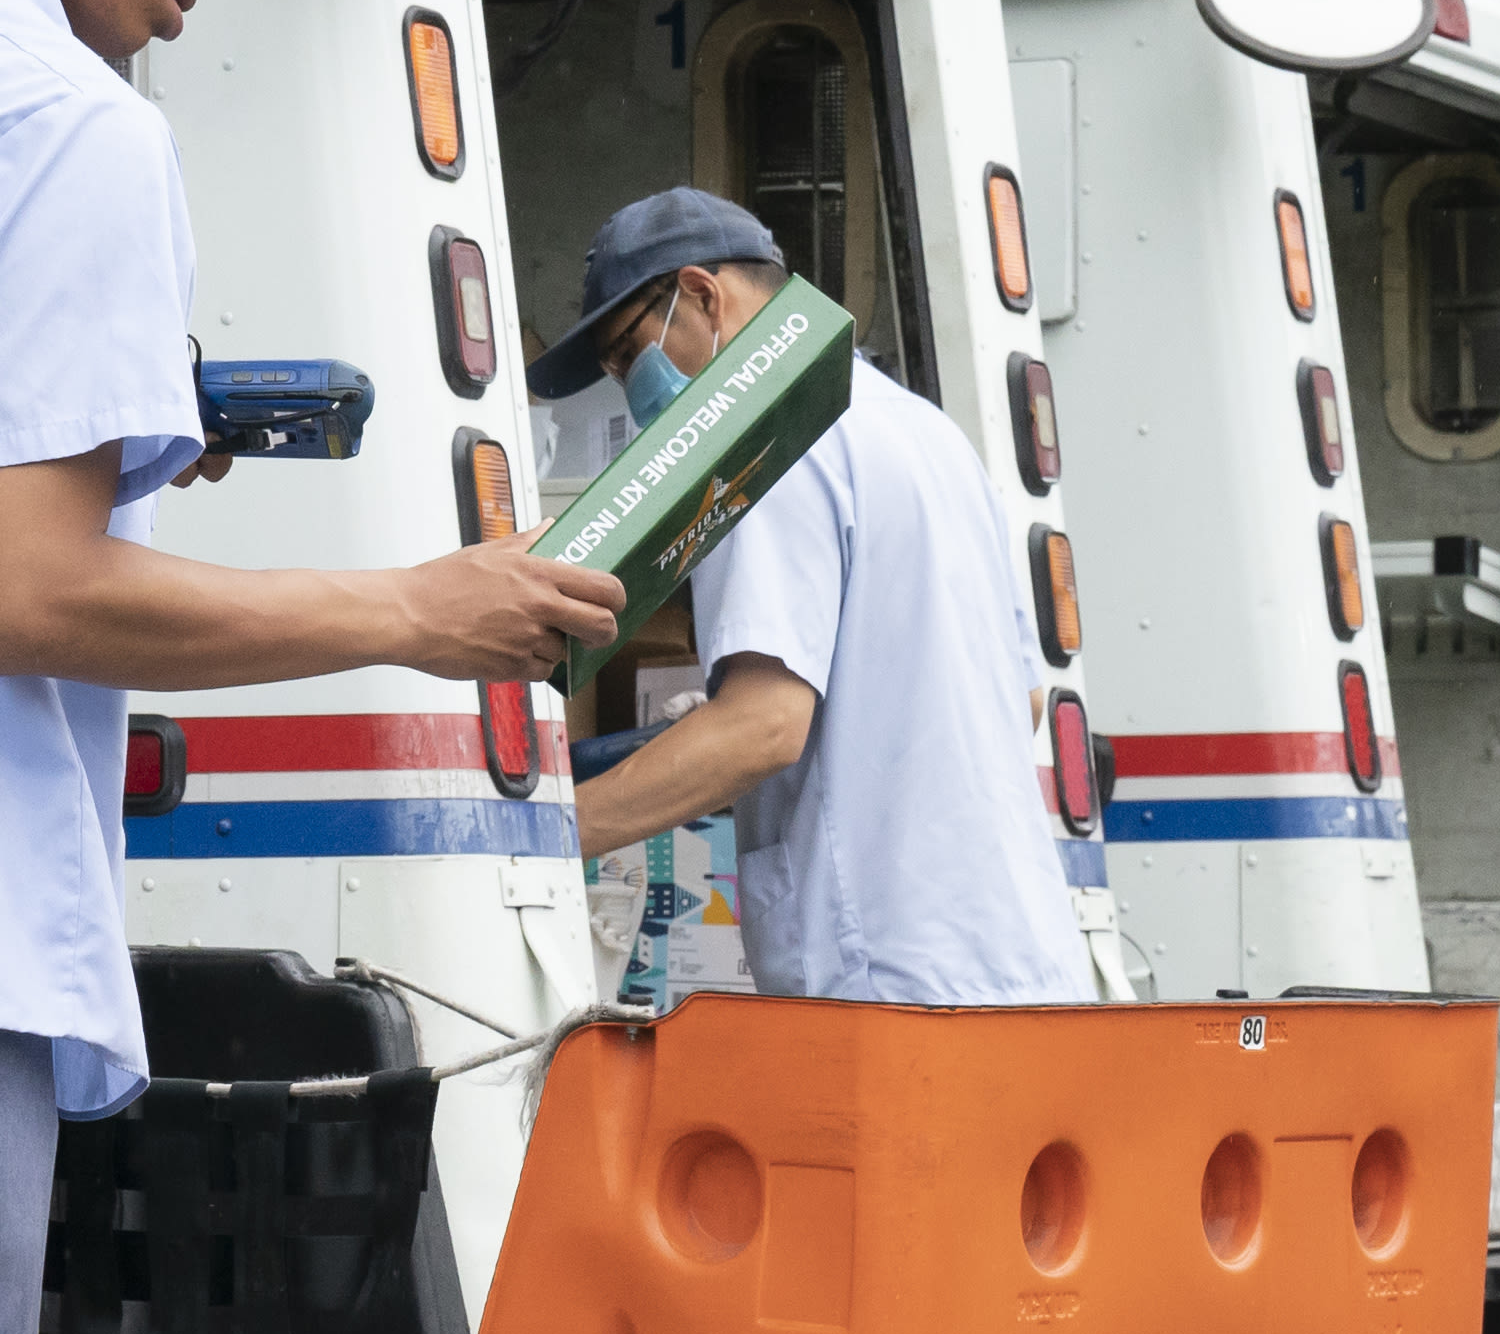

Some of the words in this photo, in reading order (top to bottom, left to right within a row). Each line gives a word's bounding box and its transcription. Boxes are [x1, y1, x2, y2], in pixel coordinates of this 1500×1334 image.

[655, 0, 686, 70] 1
[1341, 157, 1366, 212] 1
[724, 312, 809, 393] OFFICIAL
[638, 390, 737, 486] WELCOME
[612, 478, 649, 517] KIT
[660, 501, 721, 571] PATRIOT
[1243, 1019, 1262, 1044] 80
